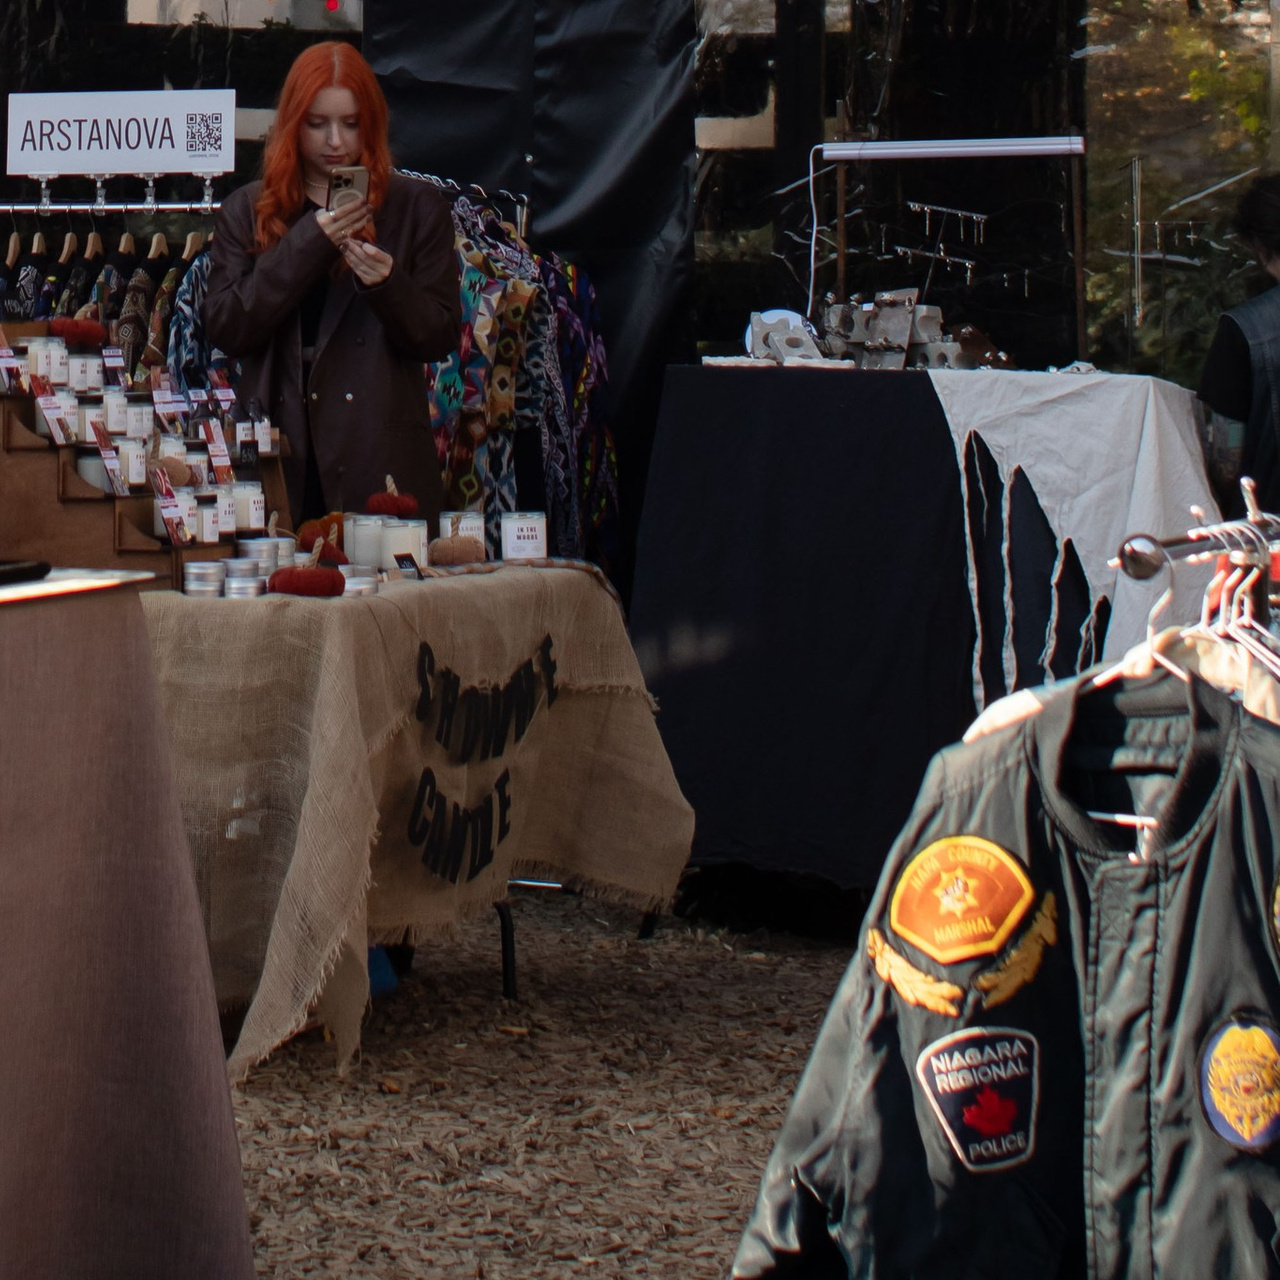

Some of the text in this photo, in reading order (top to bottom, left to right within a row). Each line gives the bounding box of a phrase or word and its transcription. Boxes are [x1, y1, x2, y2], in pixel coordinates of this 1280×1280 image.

[20, 117, 175, 151] ARSTANOVA
[948, 846, 999, 872] COUNTY
[934, 916, 995, 944] MARSHAL
[930, 1038, 1028, 1073] NIAGARA
[935, 1058, 1030, 1094] REGIONAL
[969, 1131, 1027, 1161] POLICE
